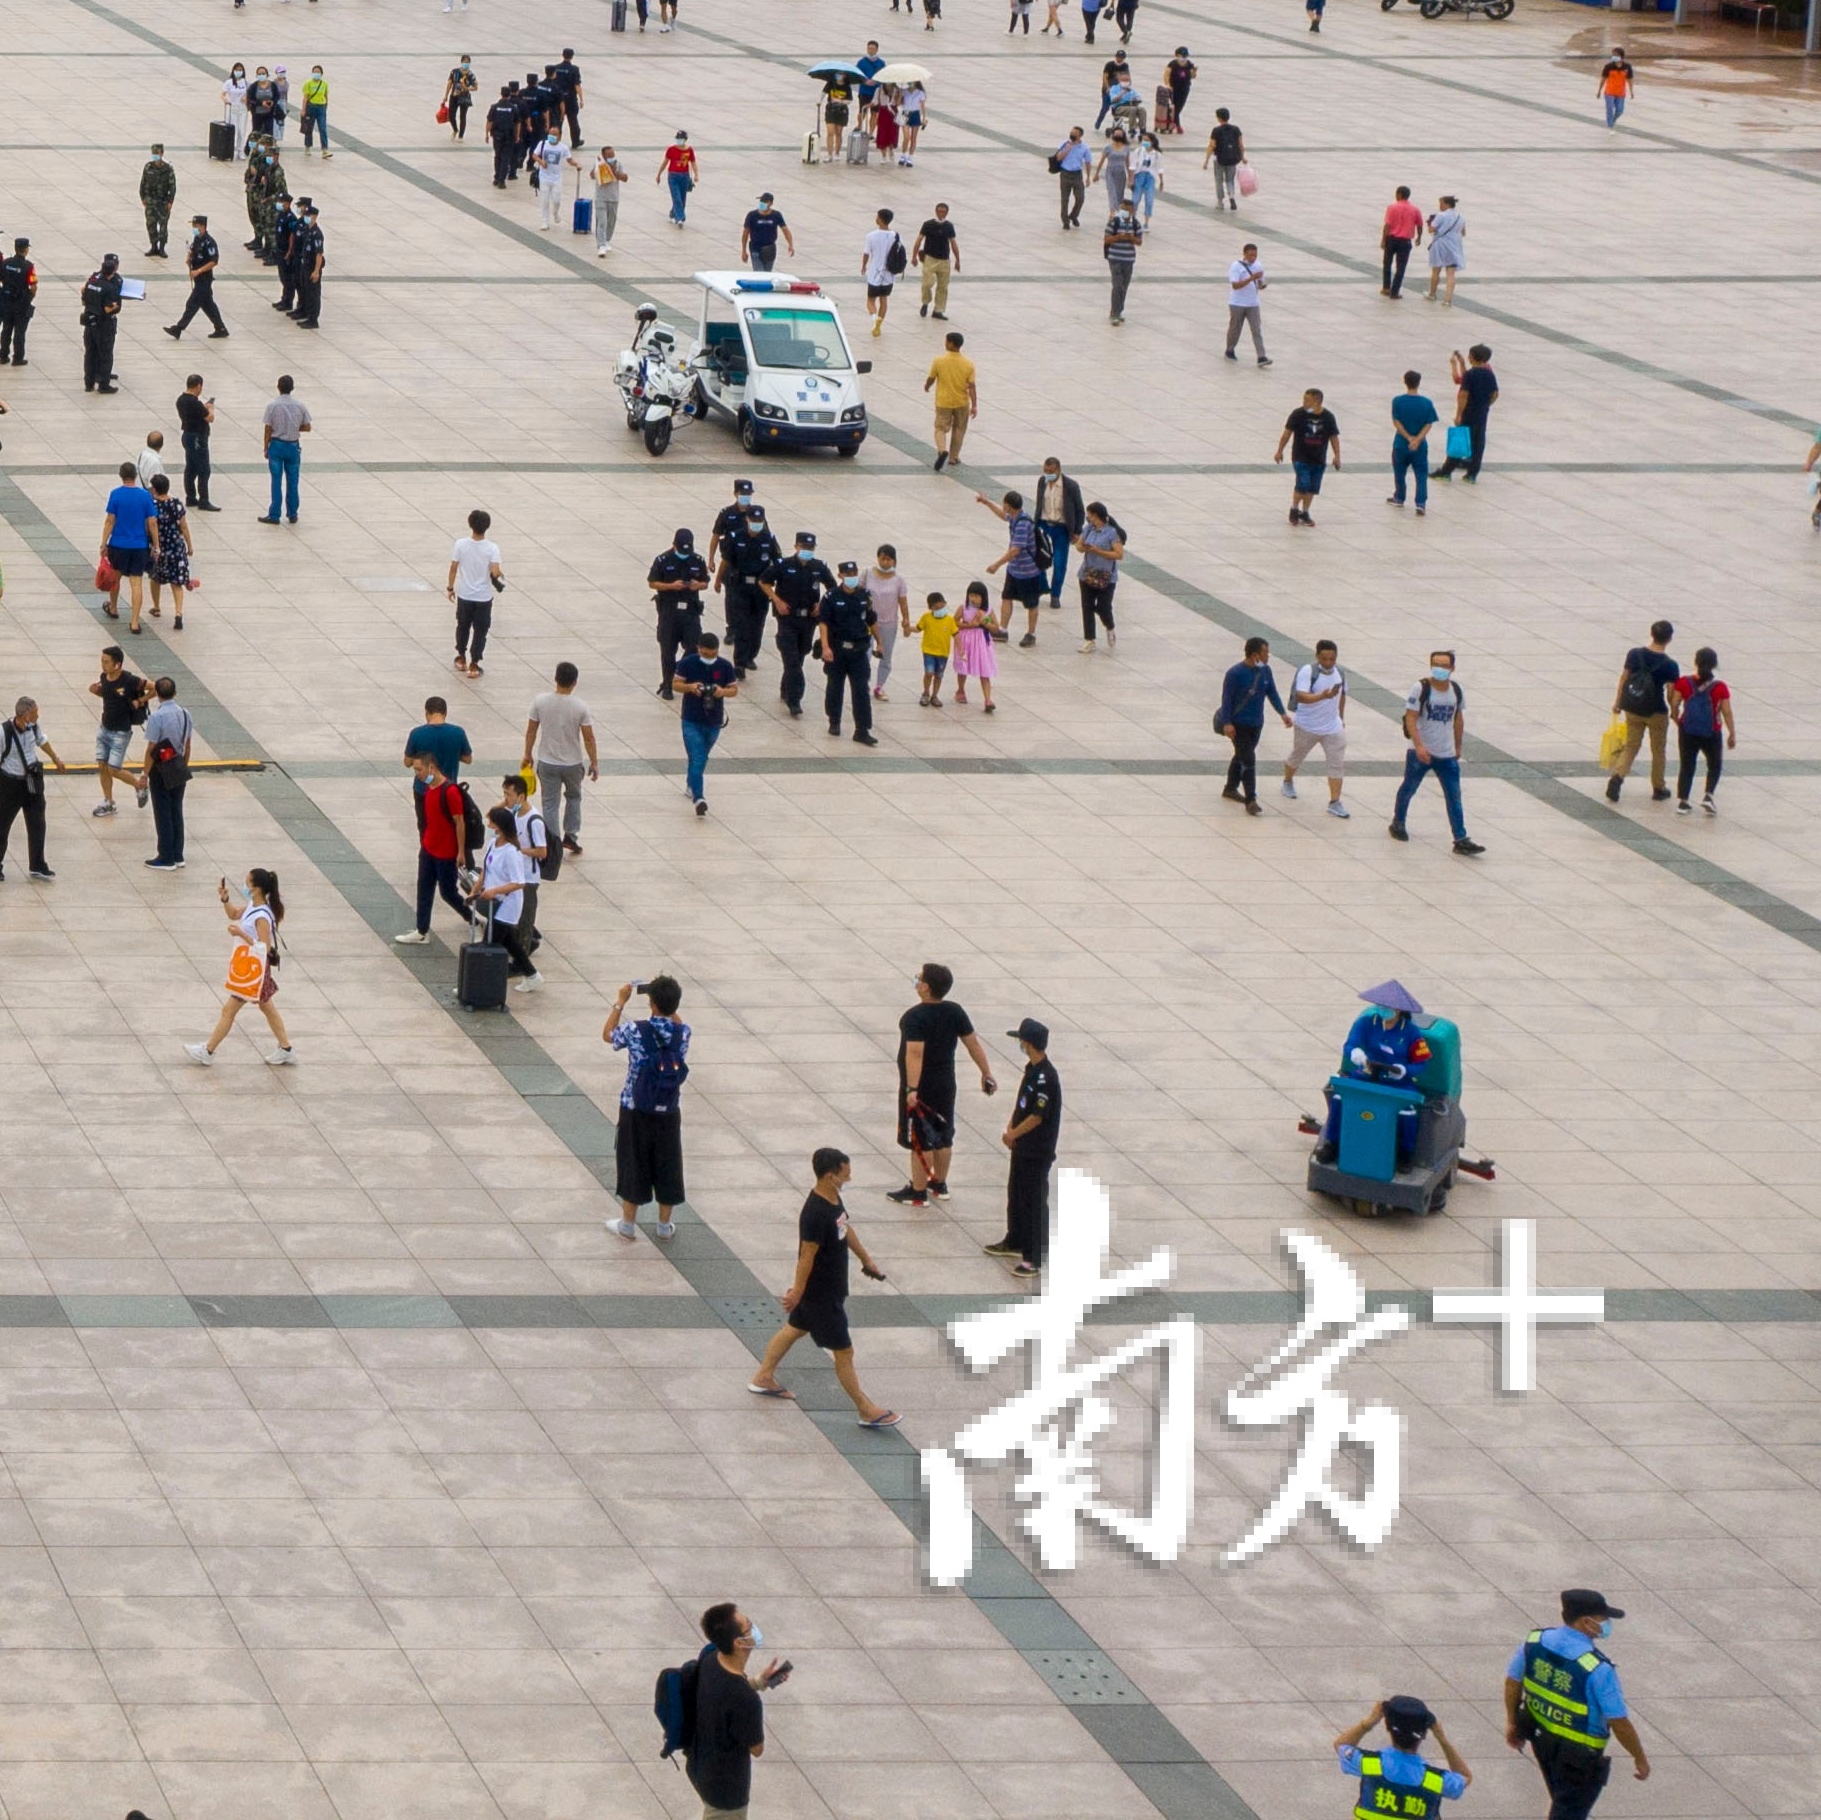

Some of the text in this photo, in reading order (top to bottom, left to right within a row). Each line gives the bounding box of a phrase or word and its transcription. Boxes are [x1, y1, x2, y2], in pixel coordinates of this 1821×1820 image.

[1532, 1657, 1574, 1693] 警察
[1525, 1694, 1574, 1727] POLICE
[1373, 1786, 1428, 1818] 执勤
